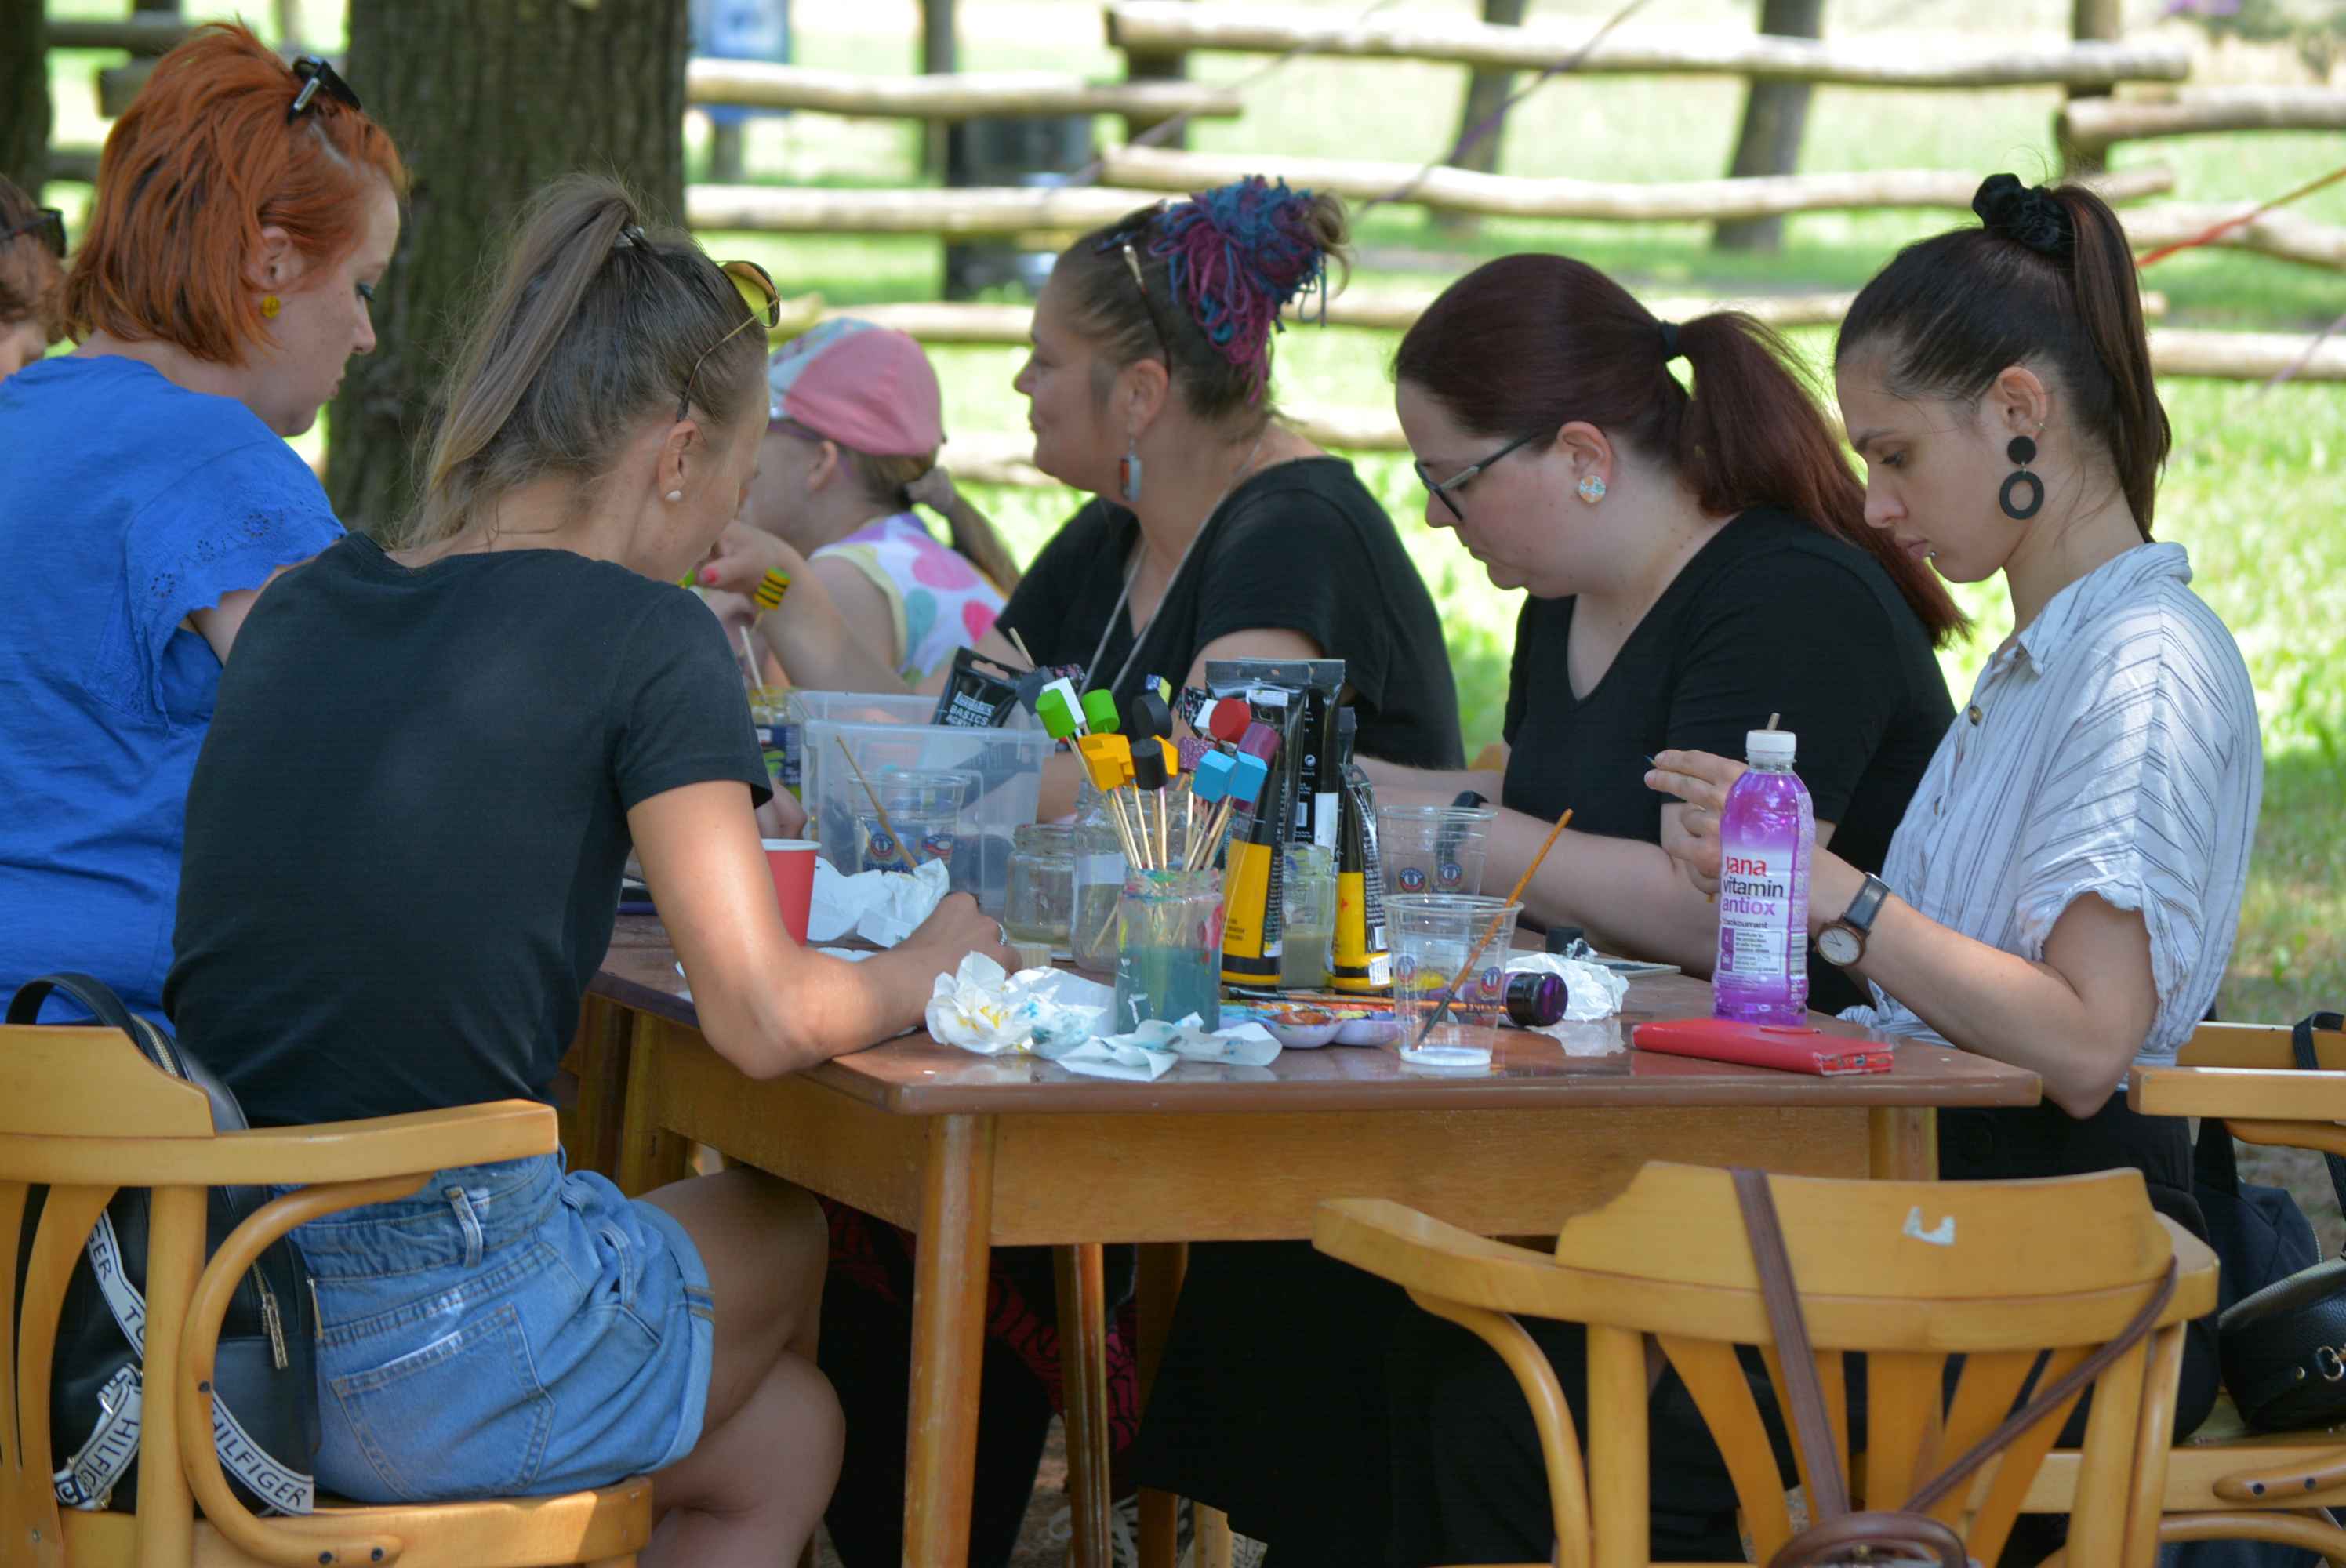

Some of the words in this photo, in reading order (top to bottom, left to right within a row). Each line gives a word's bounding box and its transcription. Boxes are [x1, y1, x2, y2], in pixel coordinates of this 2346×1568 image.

[950, 704, 990, 726] BASICS
[1723, 876, 1784, 898] vitamin
[1722, 896, 1776, 916] antiox
